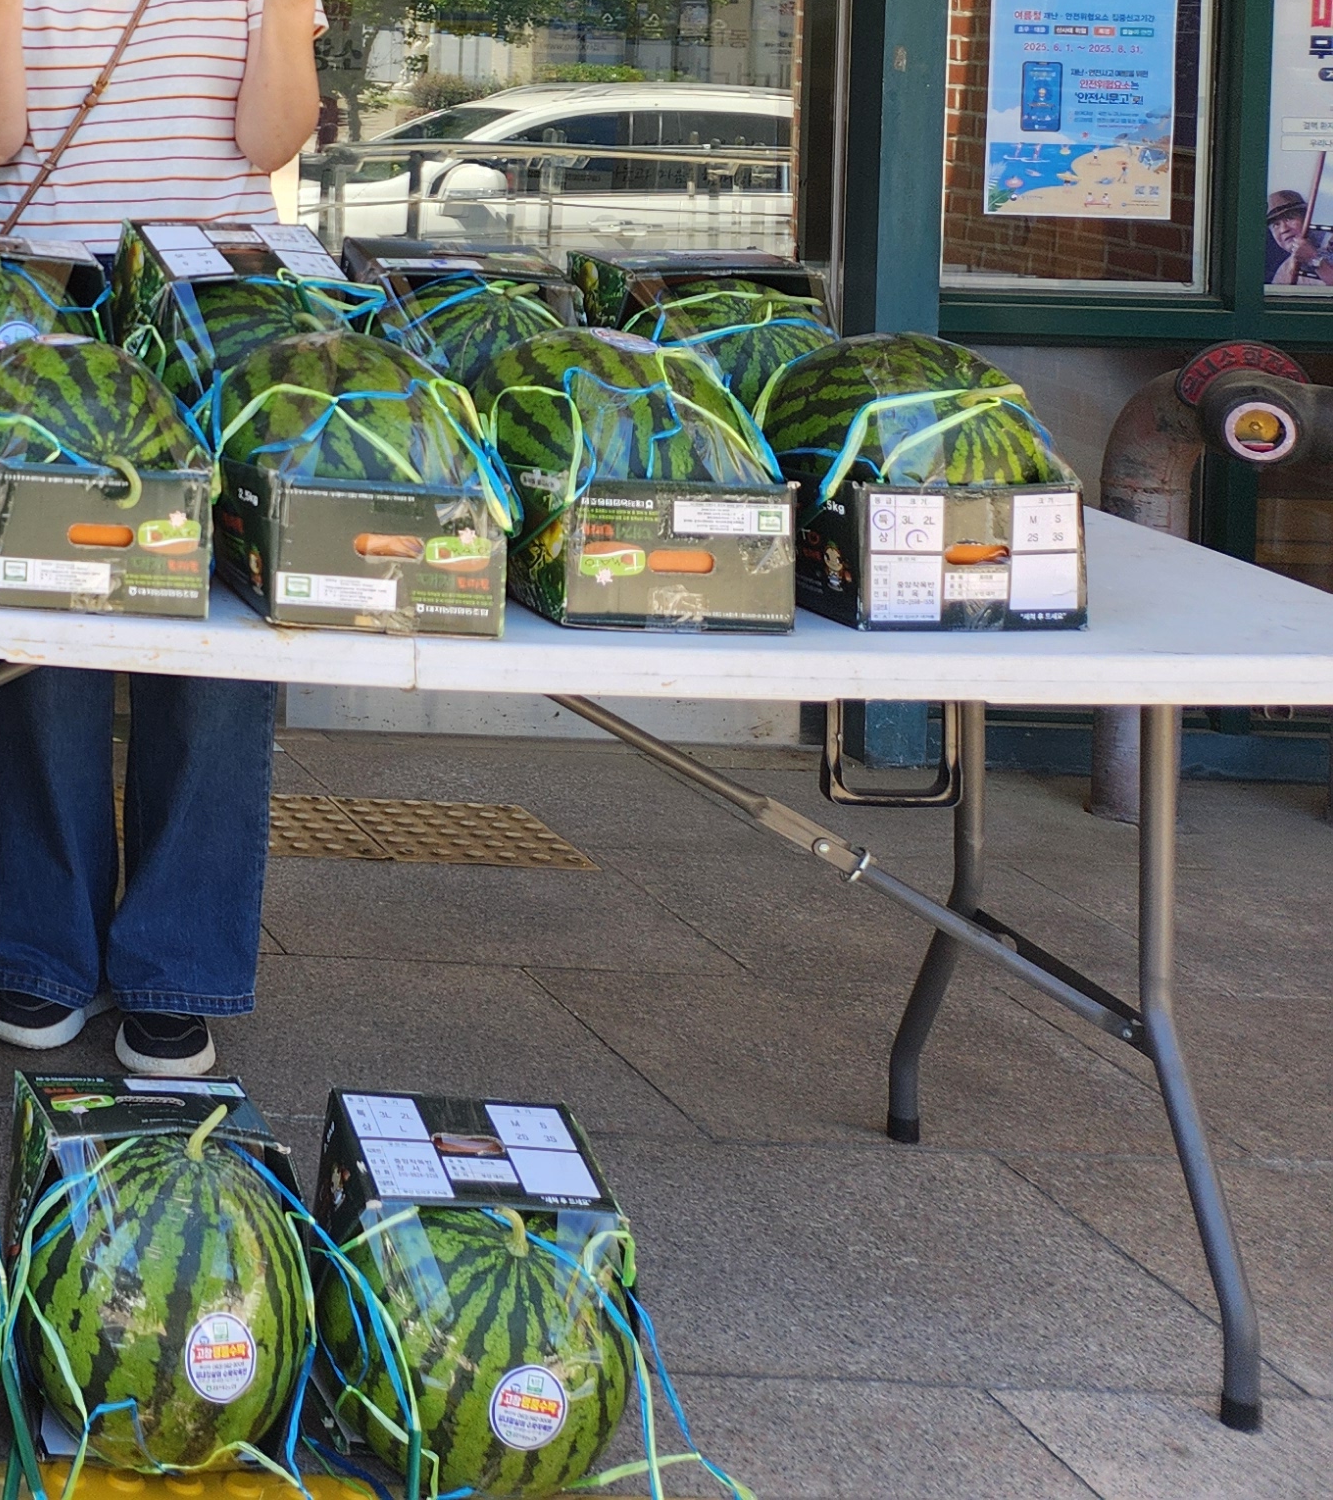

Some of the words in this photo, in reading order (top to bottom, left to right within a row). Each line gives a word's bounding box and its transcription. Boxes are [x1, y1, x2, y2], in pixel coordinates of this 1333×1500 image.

[902, 515, 914, 525] 3L
[923, 515, 936, 526] 2L
[1029, 515, 1038, 524] M
[1054, 514, 1062, 524] S
[1027, 532, 1039, 543] 2S
[1052, 532, 1065, 542] 3S
